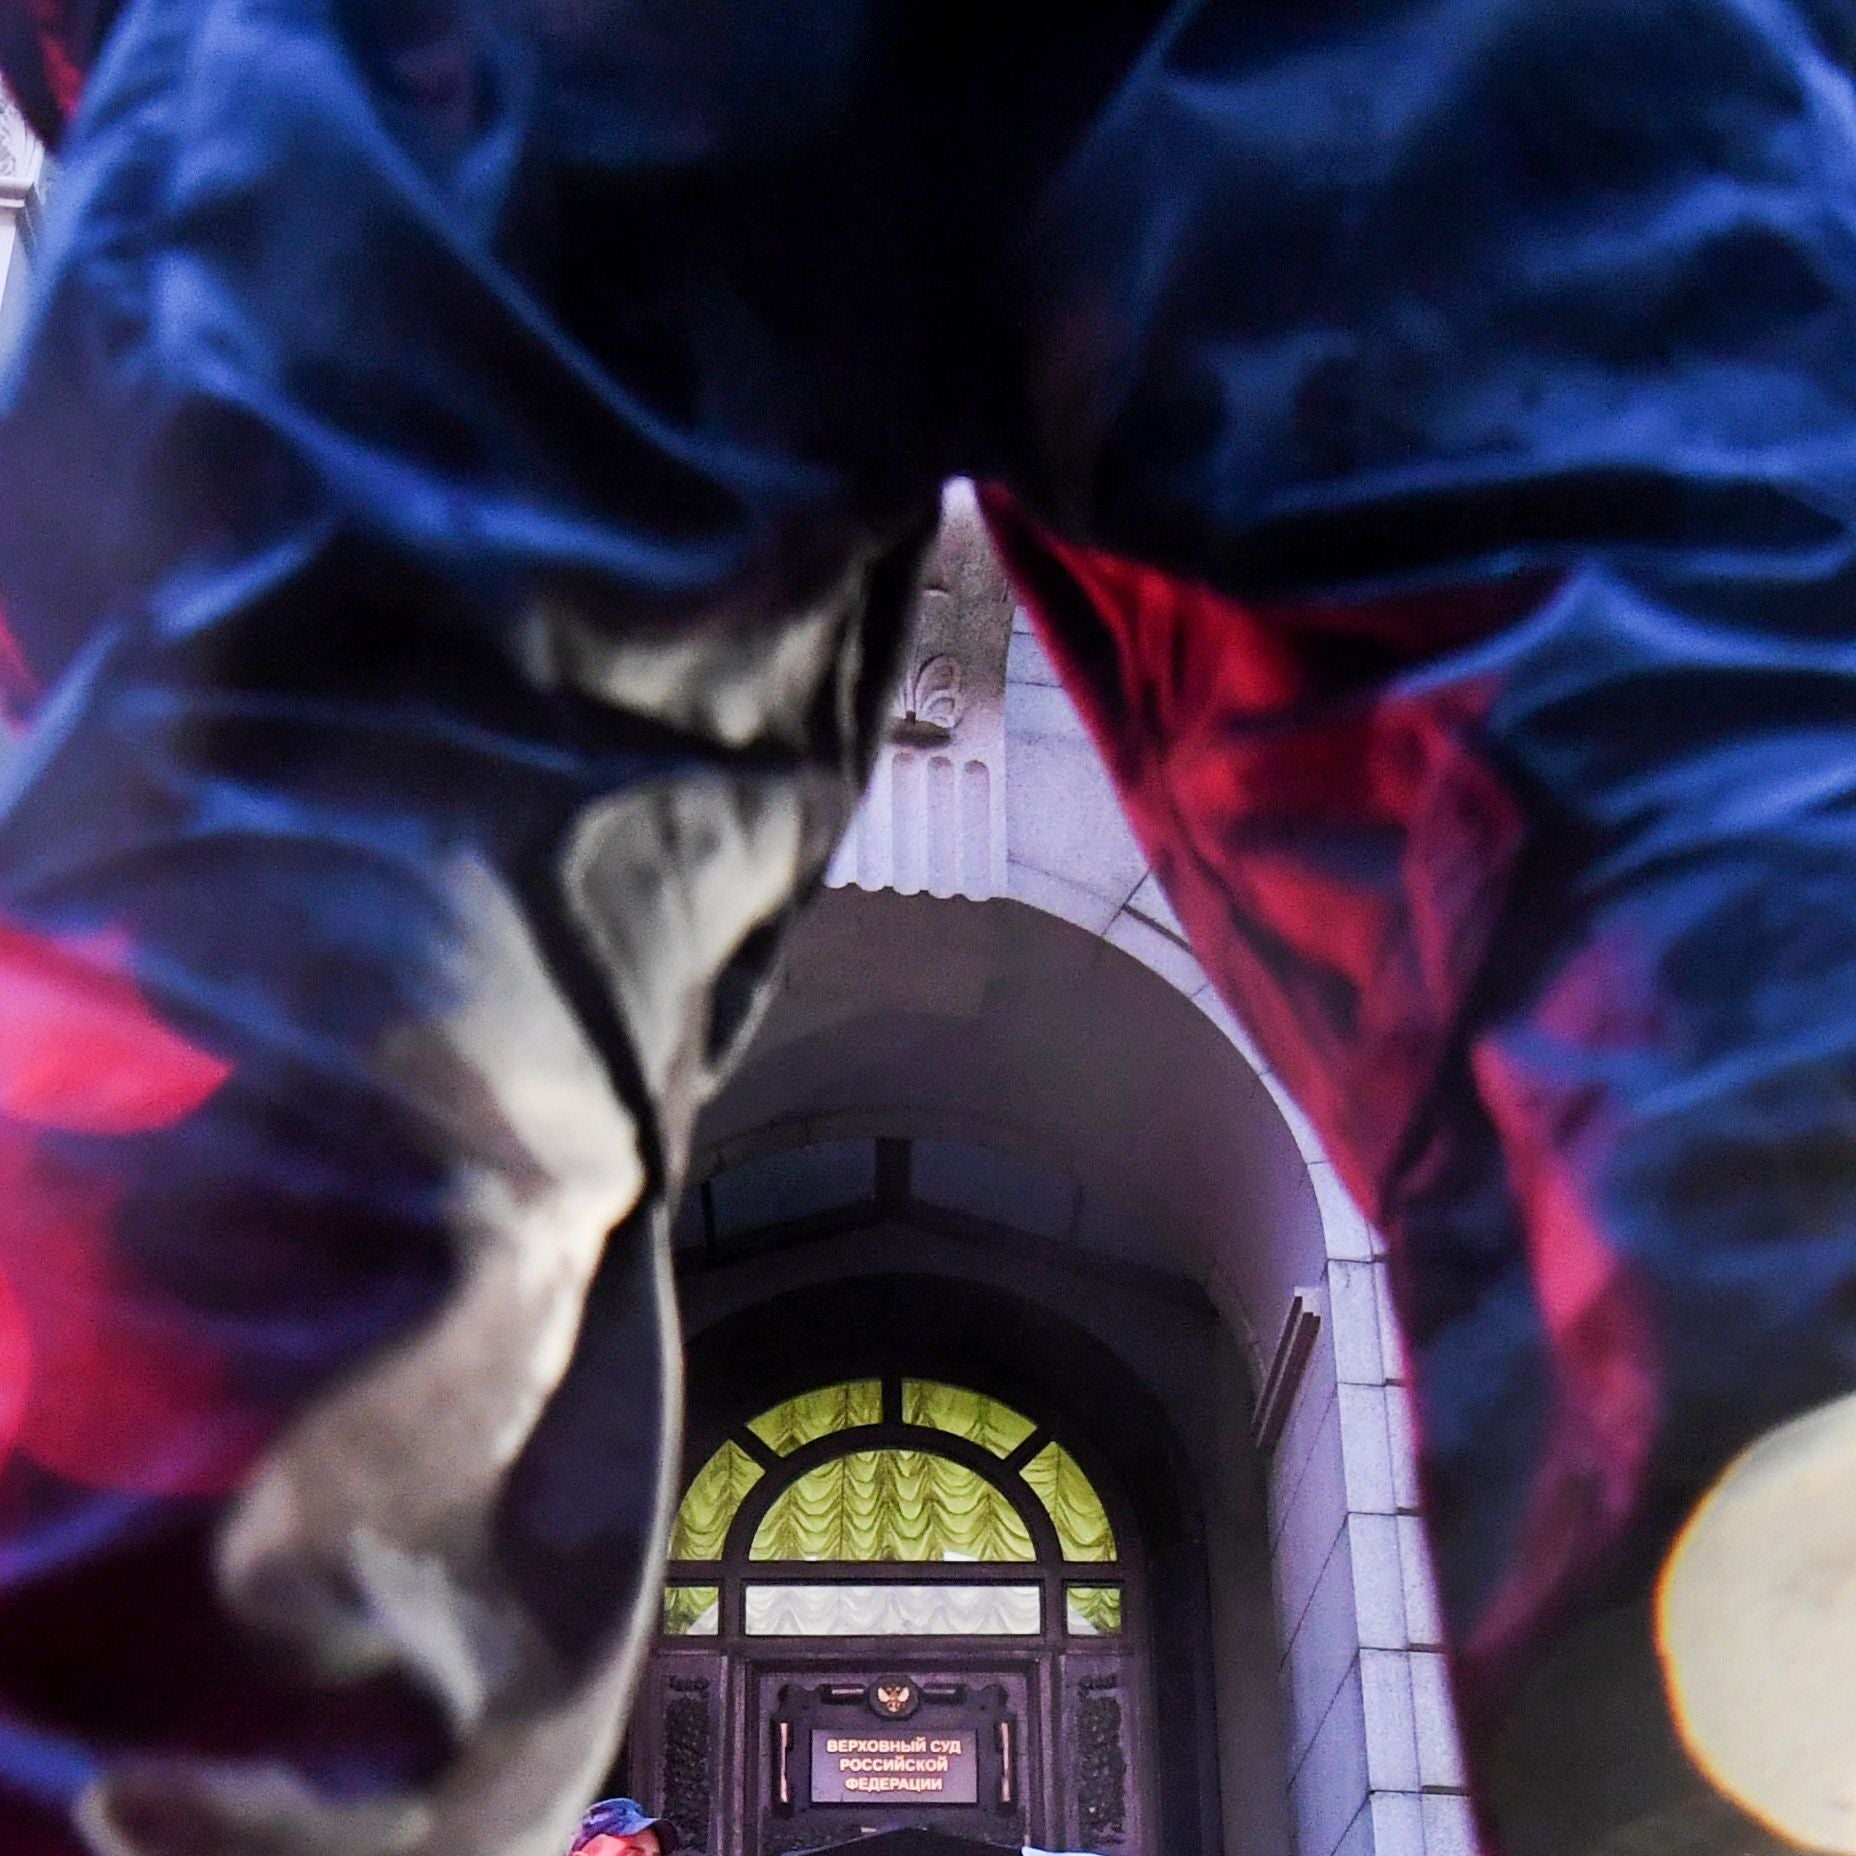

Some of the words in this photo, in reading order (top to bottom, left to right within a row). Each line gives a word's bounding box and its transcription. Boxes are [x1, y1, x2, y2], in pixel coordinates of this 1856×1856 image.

[826, 1736, 927, 1753] ВЕРХОВНЫЙ
[930, 1739, 962, 1754] СУД
[839, 1755, 949, 1772] РОССИЙСКОЙ
[845, 1776, 943, 1792] ФЕДЕРАЦИИ
